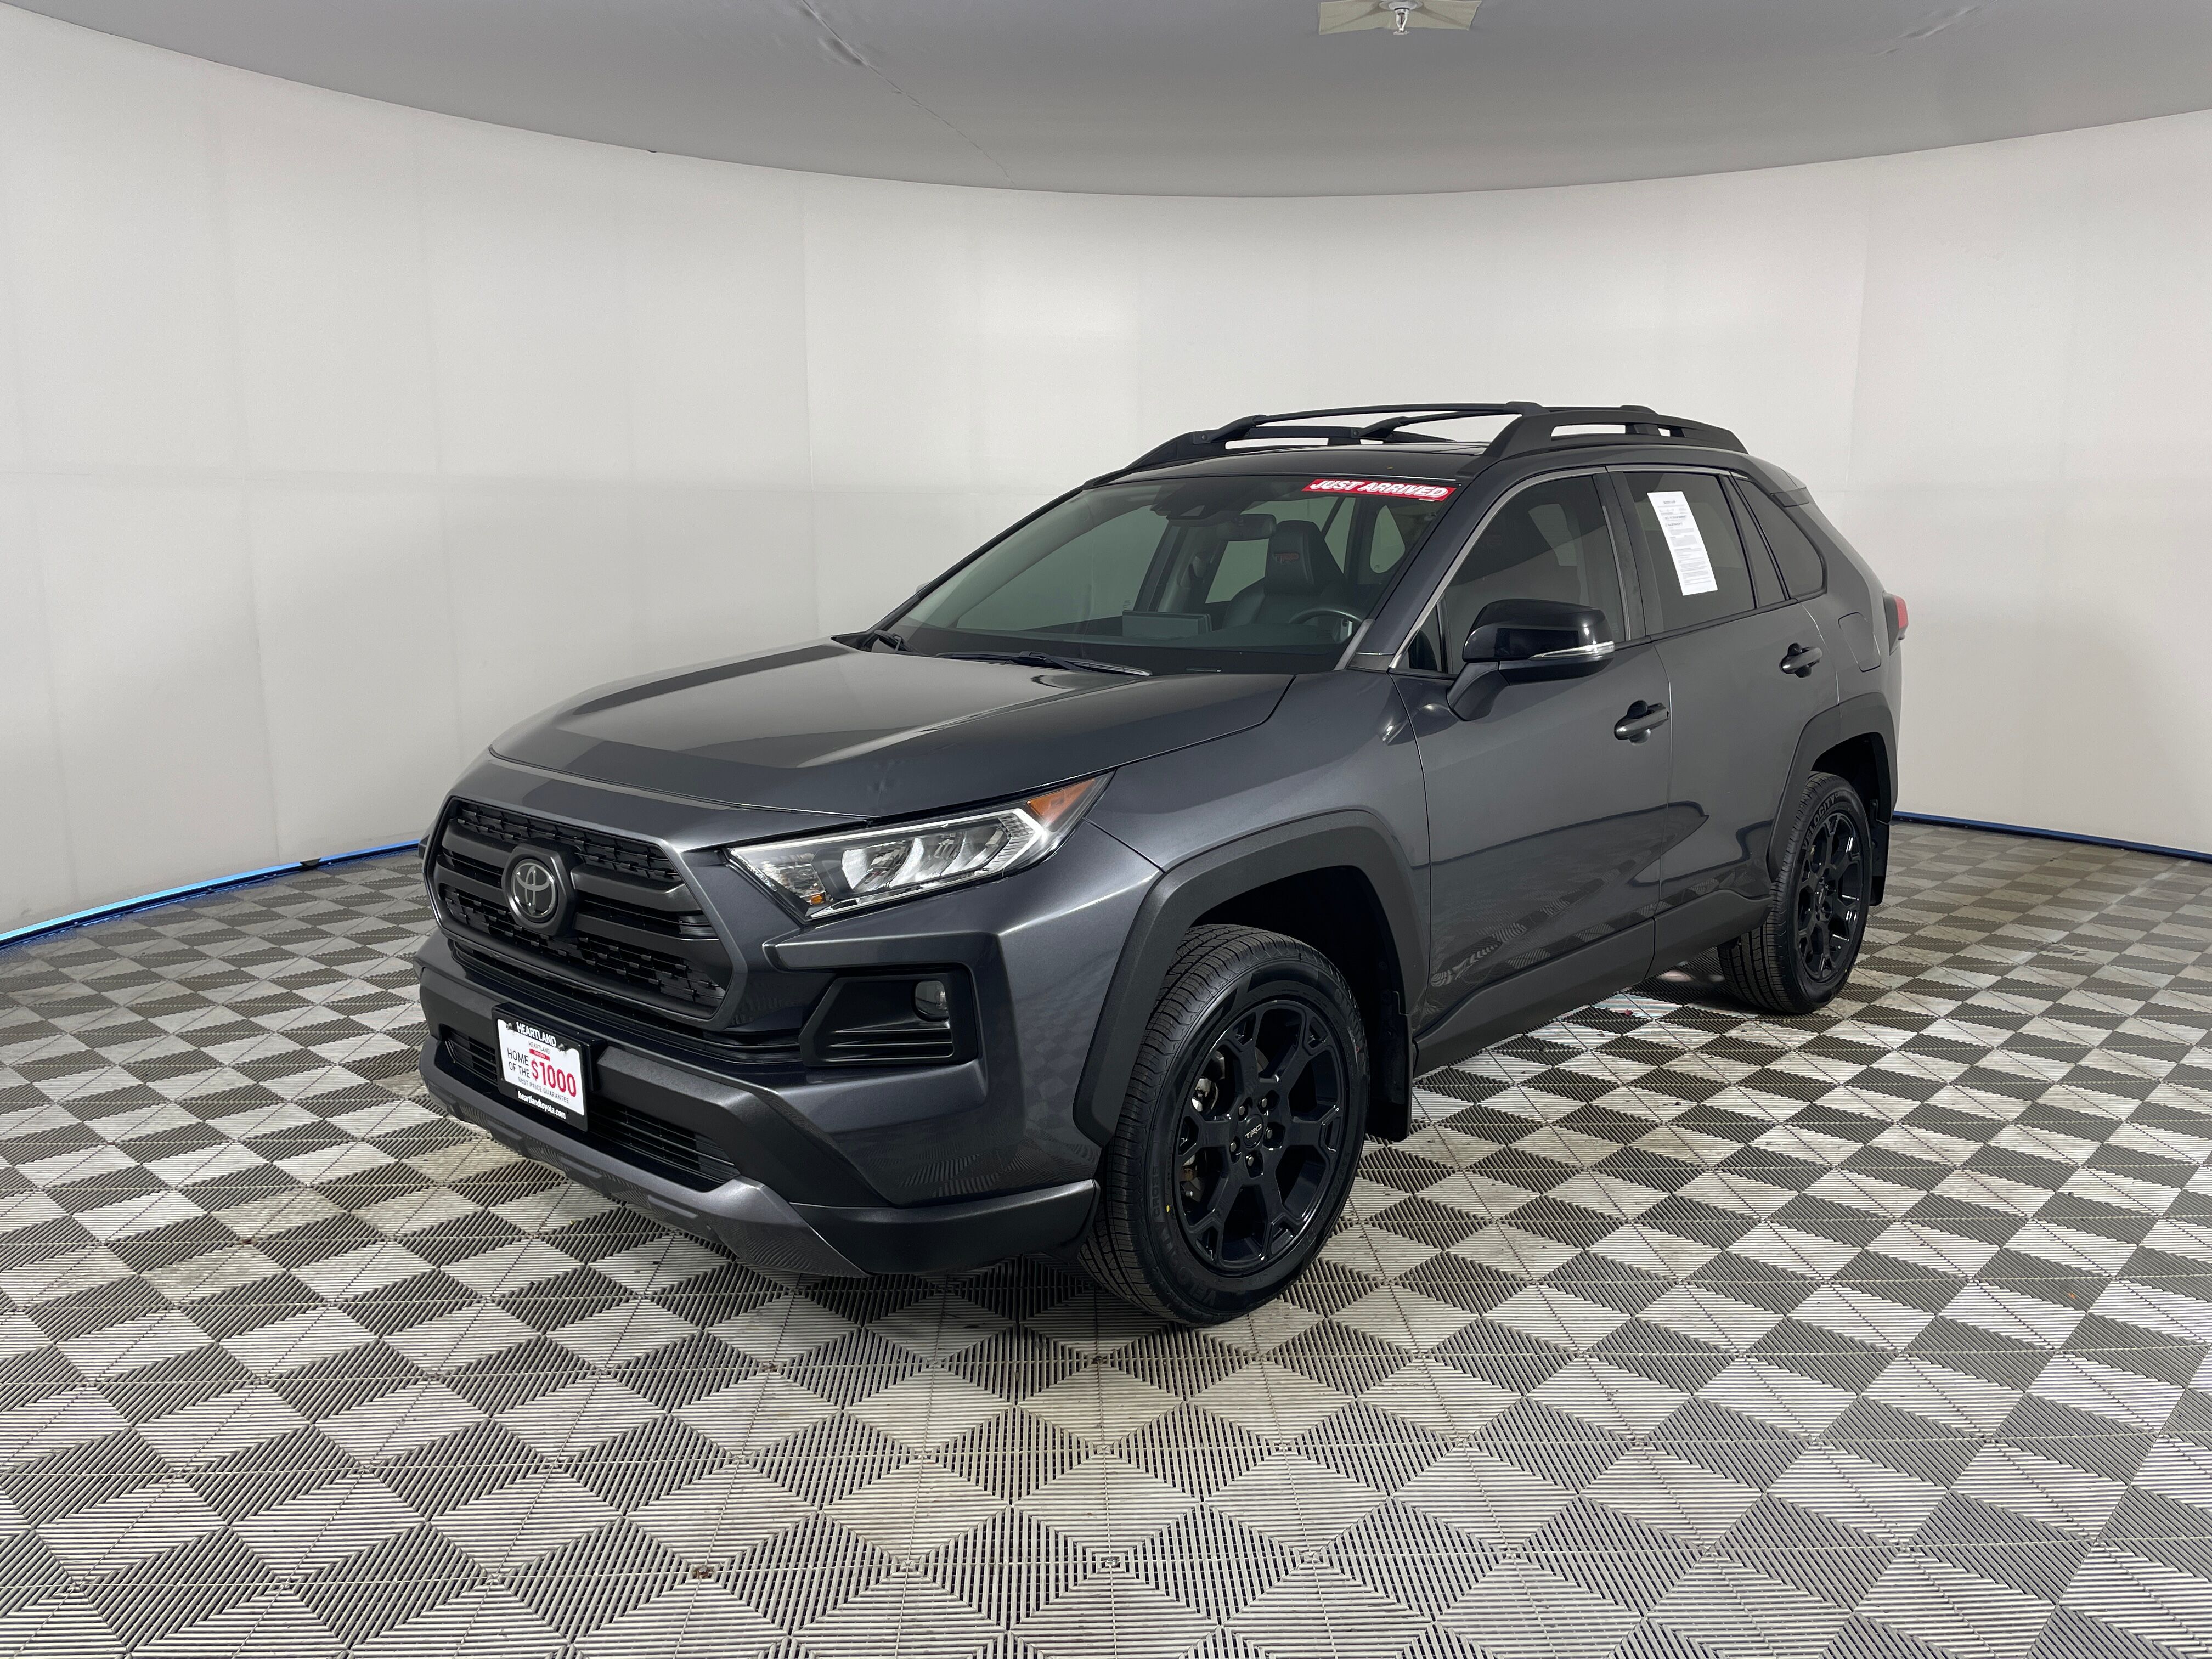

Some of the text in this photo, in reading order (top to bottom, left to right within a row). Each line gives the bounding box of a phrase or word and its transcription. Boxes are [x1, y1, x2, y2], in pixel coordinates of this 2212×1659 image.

[1310, 480, 1449, 498] JUST ARRIVED
[1802, 793, 1835, 849] VELOCITY
[516, 1022, 557, 1047] HEARTLAND
[507, 1047, 529, 1066] HOME
[528, 1041, 550, 1054] HEARTLAND
[509, 1062, 531, 1079] OF THE
[531, 1058, 576, 1097] $1000
[518, 1076, 569, 1104] BEST PRICE GUARANTEE
[517, 1090, 566, 1119] heartlandtoyota.com
[1244, 1123, 1262, 1139] TRD
[1152, 1165, 1161, 1217] CROSS
